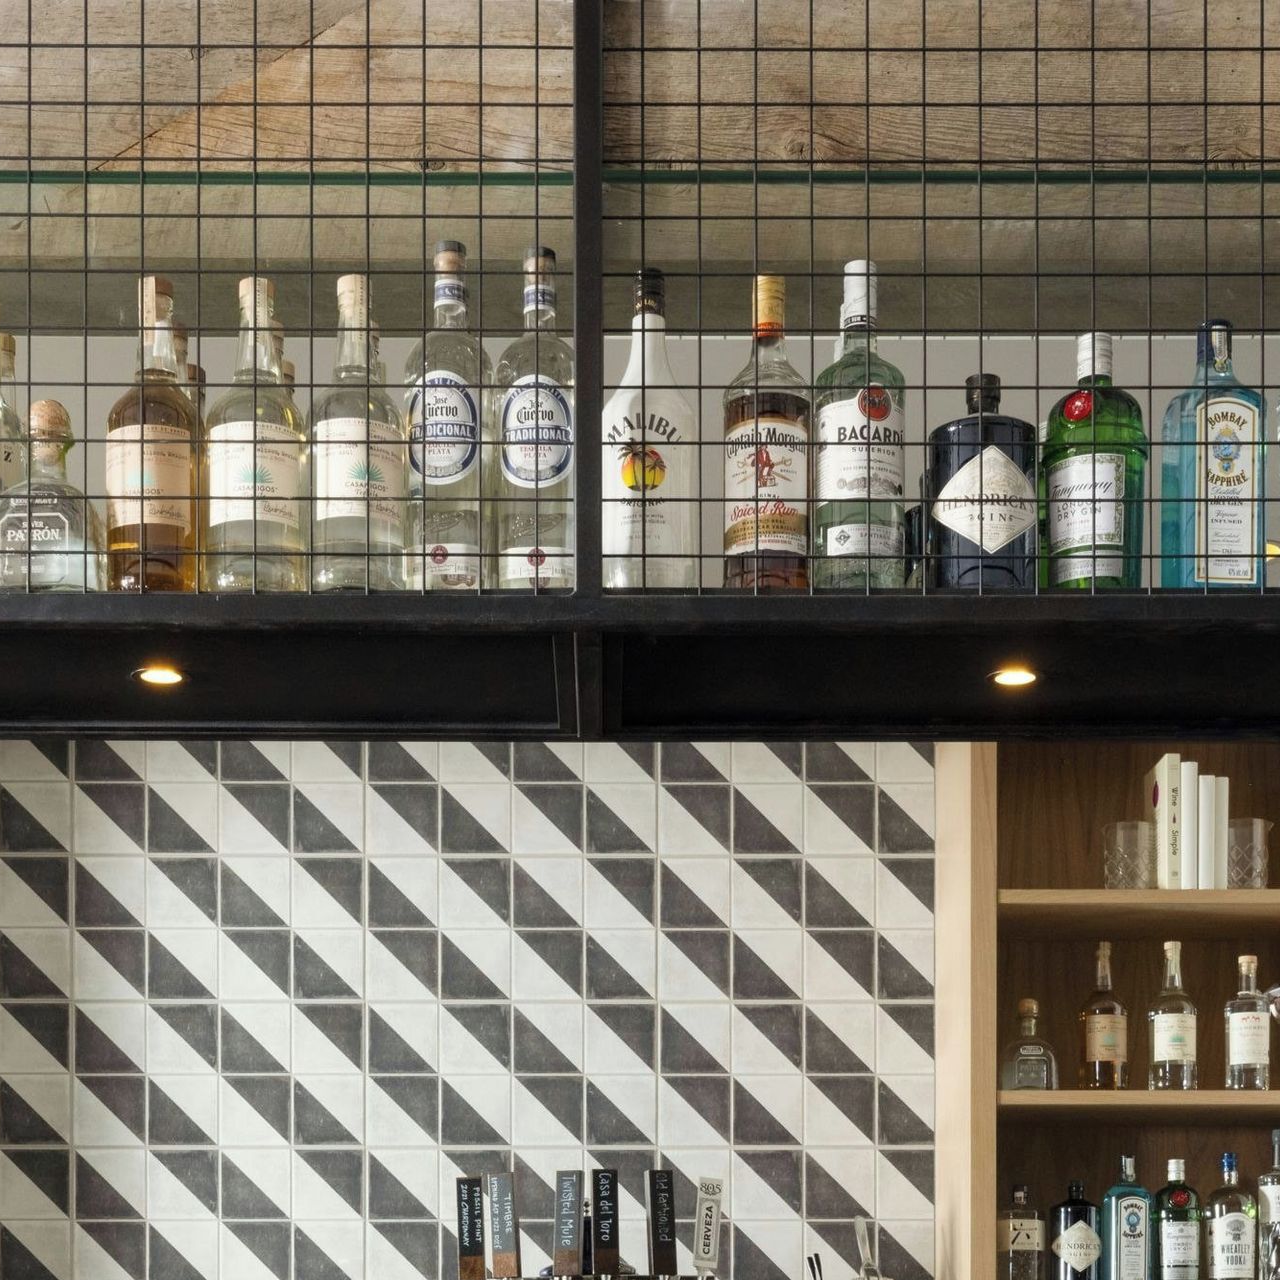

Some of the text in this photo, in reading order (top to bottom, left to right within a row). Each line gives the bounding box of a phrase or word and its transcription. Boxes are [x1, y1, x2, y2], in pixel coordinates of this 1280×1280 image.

[1207, 411, 1248, 431] BOMBAY
[411, 423, 471, 440] TRADICIONAL
[505, 427, 567, 442] TRADICIONAL
[607, 412, 683, 449] MALIBU
[1206, 468, 1250, 487] SAPPHIRE
[22, 520, 44, 529] SIVER
[1057, 510, 1076, 523] DRY
[1170, 786, 1180, 857] Wine Simple
[699, 1181, 722, 1195] 805
[504, 1191, 513, 1234] TIMBRE
[560, 1173, 577, 1247] Twisted Mule
[598, 1172, 614, 1242] Casa del Toro
[1123, 1202, 1144, 1211] BOMBAY
[702, 1205, 714, 1255] CERVEZA
[1122, 1231, 1144, 1240] SAPPHIRE
[1221, 1243, 1251, 1255] WHEATLEY
[1225, 1255, 1247, 1266] VODKA
